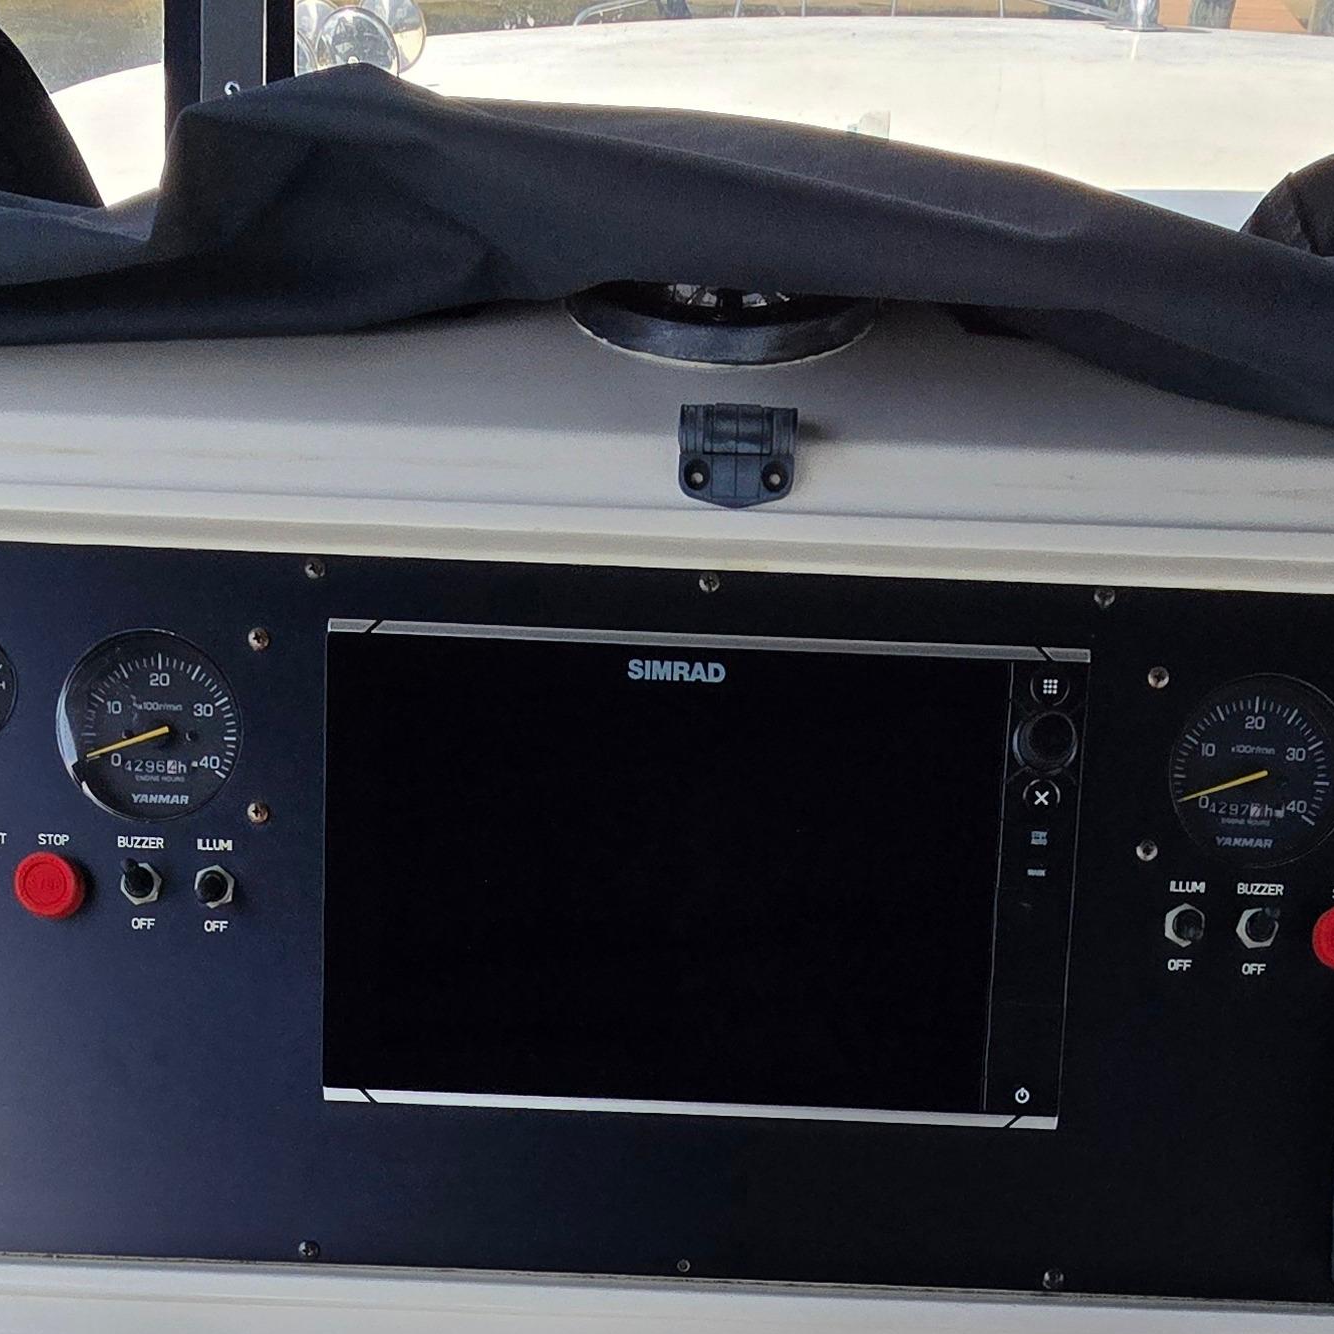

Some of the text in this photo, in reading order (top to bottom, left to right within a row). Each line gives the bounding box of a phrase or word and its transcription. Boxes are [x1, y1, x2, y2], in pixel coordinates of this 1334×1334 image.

[627, 659, 726, 683] SIMRAD
[149, 673, 170, 687] 20
[106, 700, 122, 714] 10
[193, 703, 214, 717] 30
[1244, 715, 1266, 730] 20
[1201, 743, 1216, 757] 10
[1285, 747, 1306, 762] 30
[110, 753, 122, 767] 0
[199, 755, 220, 769] 40
[131, 793, 189, 805] YANMAR
[1198, 795, 1209, 809] 0
[1286, 800, 1308, 814] 40
[38, 833, 70, 847] STOP
[117, 835, 165, 849] BUZZER
[196, 838, 234, 851] ILLUMI
[1215, 836, 1274, 849] YANMAR
[1169, 880, 1206, 894] ILLUMI
[1237, 882, 1284, 896] BUZZER
[131, 917, 156, 930] OFF
[203, 920, 229, 933] OFF
[1167, 959, 1192, 972] OFF
[1241, 963, 1266, 976] OFF
